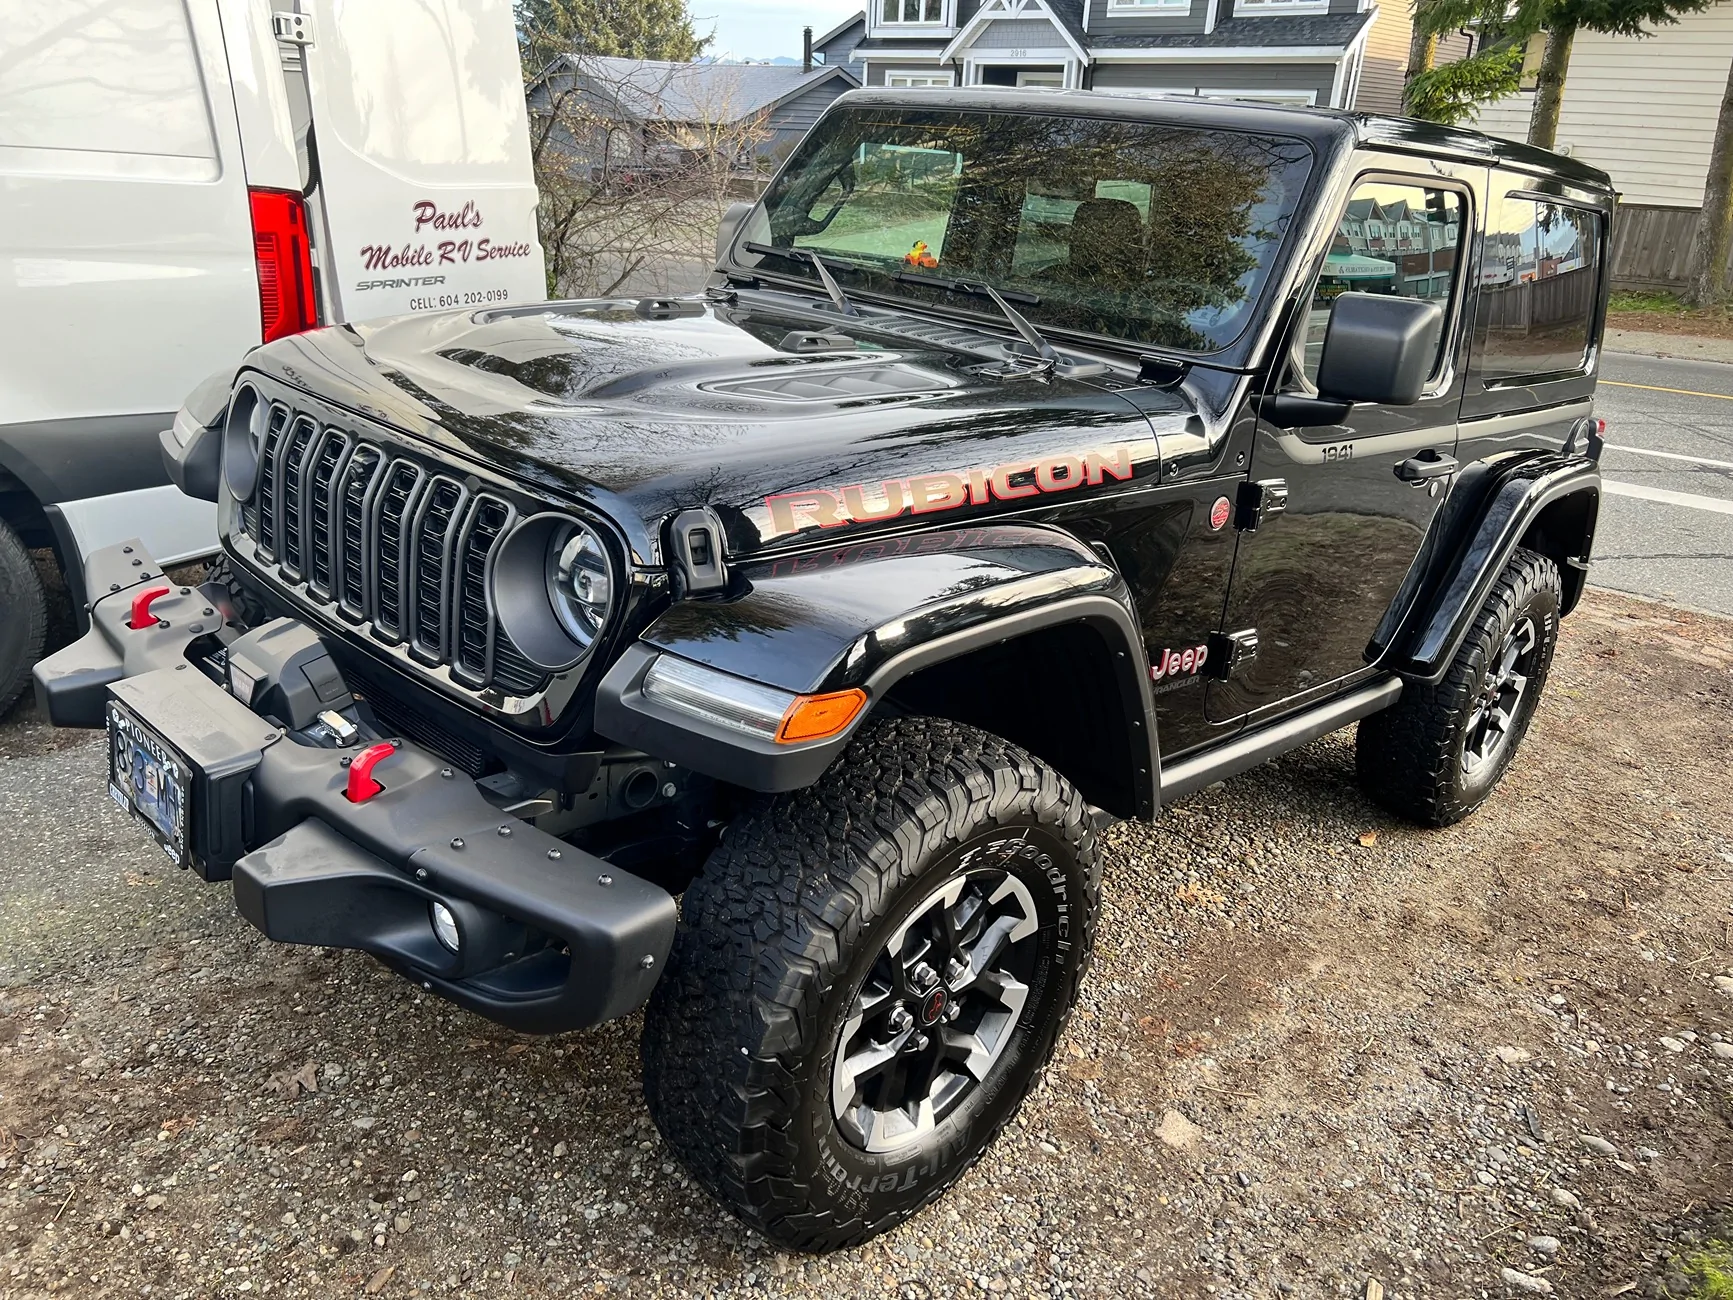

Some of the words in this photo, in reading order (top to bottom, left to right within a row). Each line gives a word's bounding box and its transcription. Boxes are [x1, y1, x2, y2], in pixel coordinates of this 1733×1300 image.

[1010, 49, 1027, 57] 2916
[413, 200, 483, 233] Paul's
[360, 242, 434, 270] Mobile
[437, 238, 474, 266] RV
[475, 237, 532, 261] Service
[355, 275, 446, 291] SPRINTER
[410, 297, 437, 310] CELL:
[439, 294, 460, 307] 604
[464, 289, 509, 304] 202-0199
[1321, 443, 1354, 464] 1941
[764, 448, 1133, 535] RUBICON
[1151, 644, 1209, 681] Jeep
[124, 717, 168, 765] PIONEER
